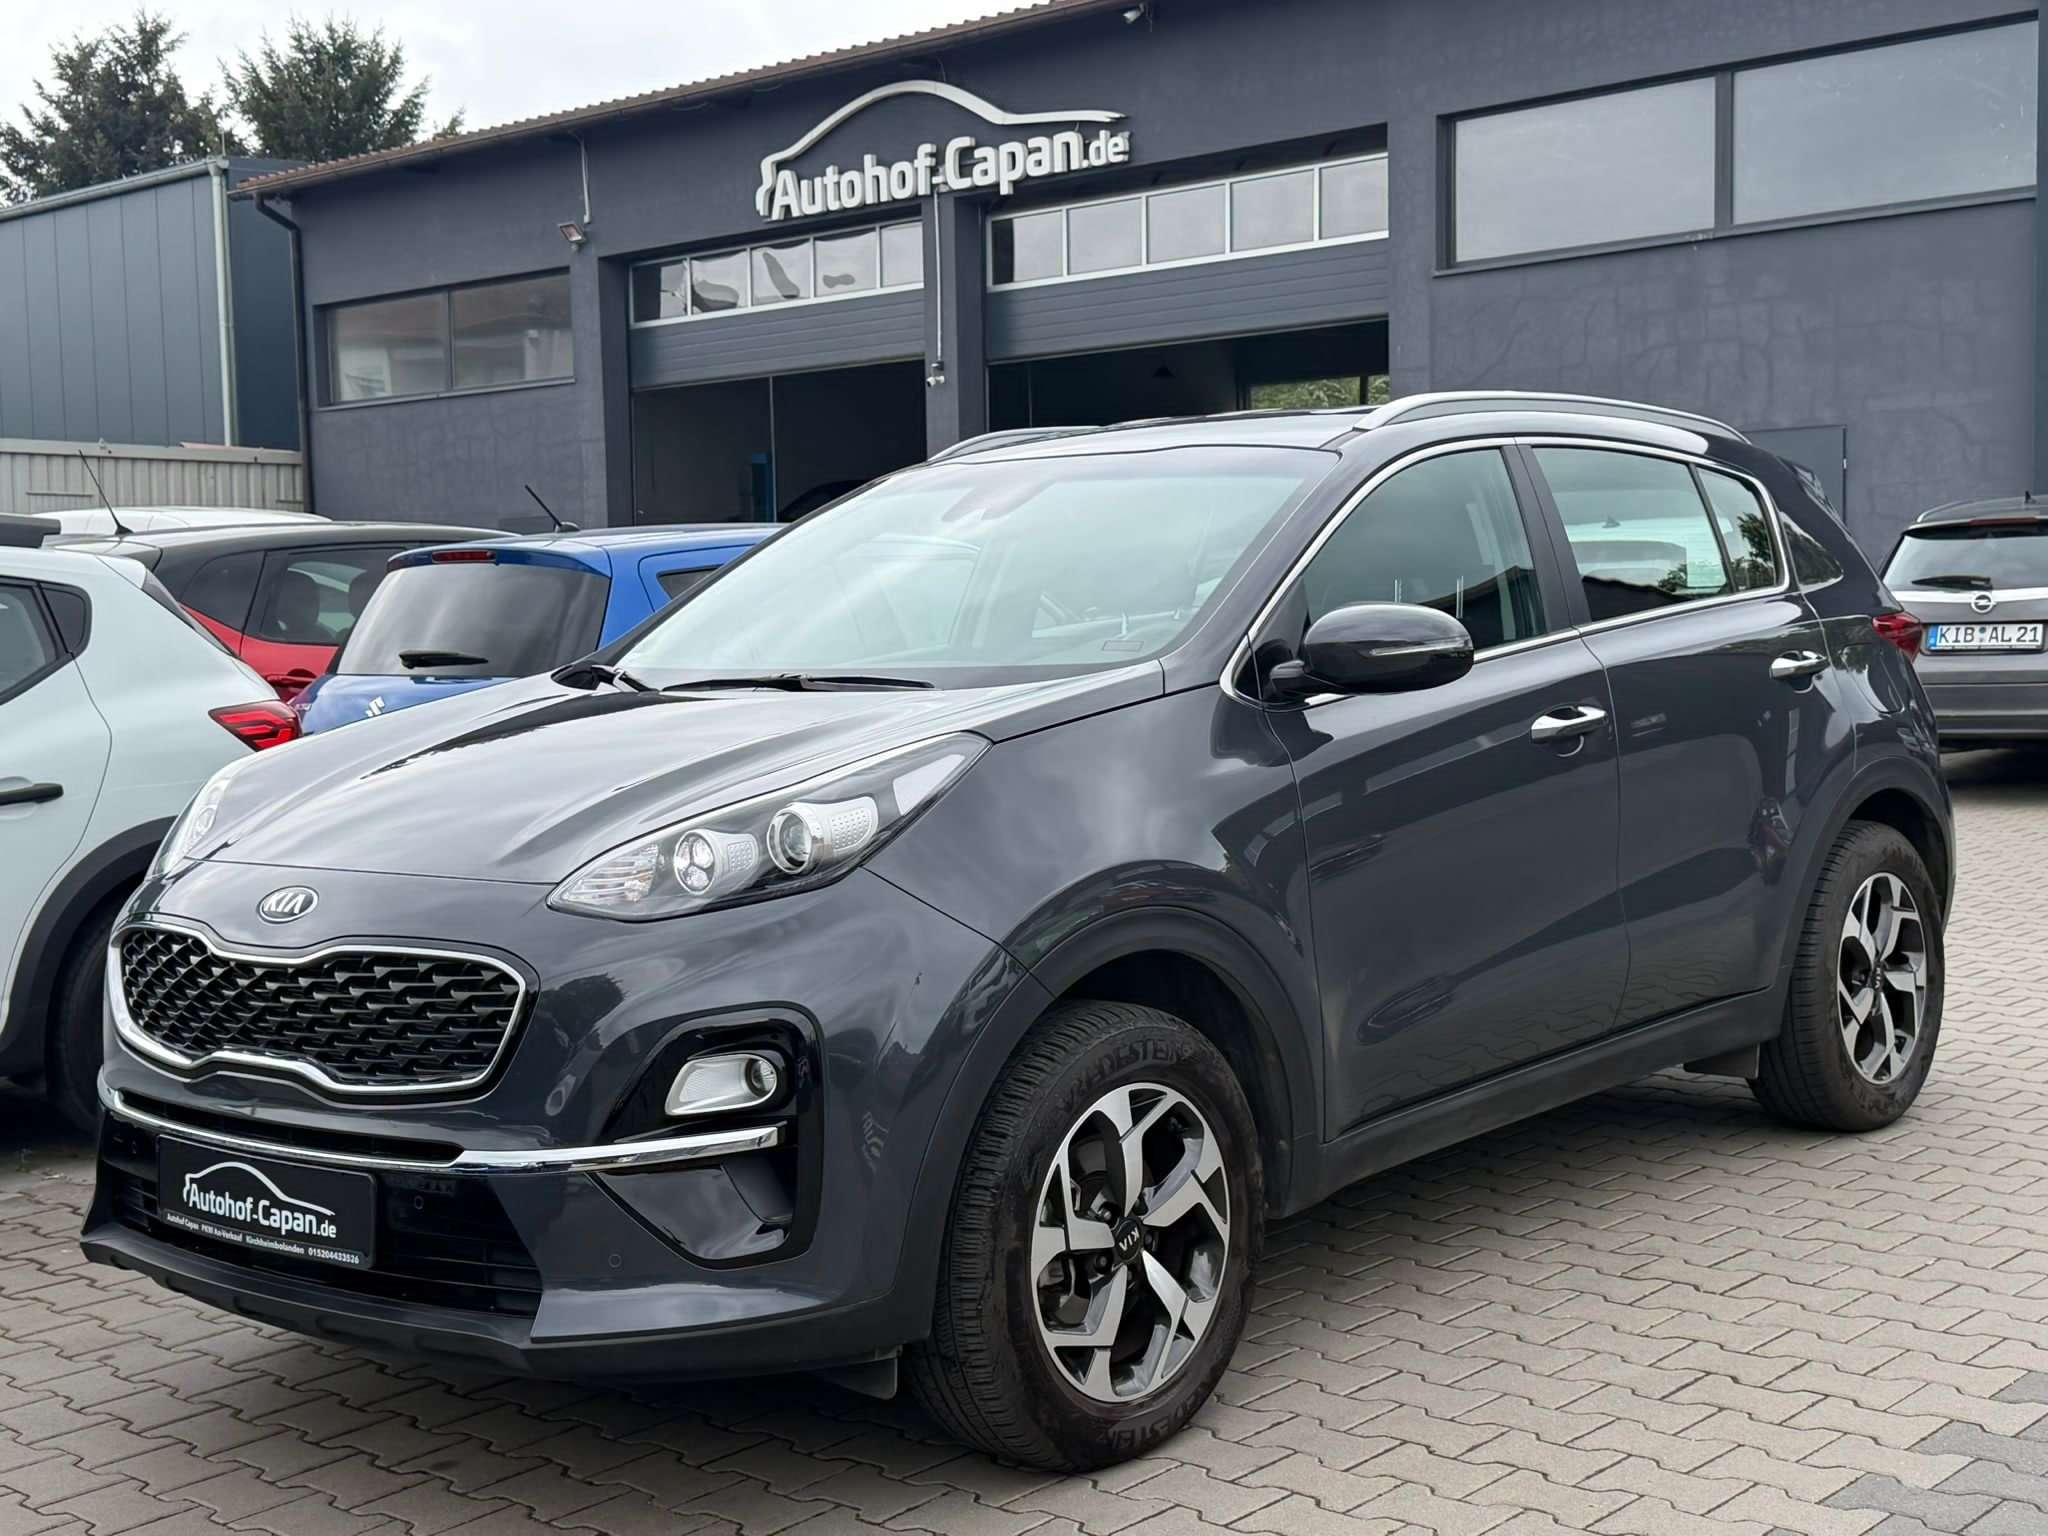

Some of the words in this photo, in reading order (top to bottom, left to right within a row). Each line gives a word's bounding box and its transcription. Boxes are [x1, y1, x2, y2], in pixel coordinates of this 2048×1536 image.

[1938, 626, 1975, 643] KIB
[1988, 626, 2012, 643] AL
[2016, 626, 2039, 643] 21
[263, 892, 306, 914] KIA
[188, 1182, 337, 1239] Autohof-Capan.de
[1118, 1226, 1141, 1252] KIA
